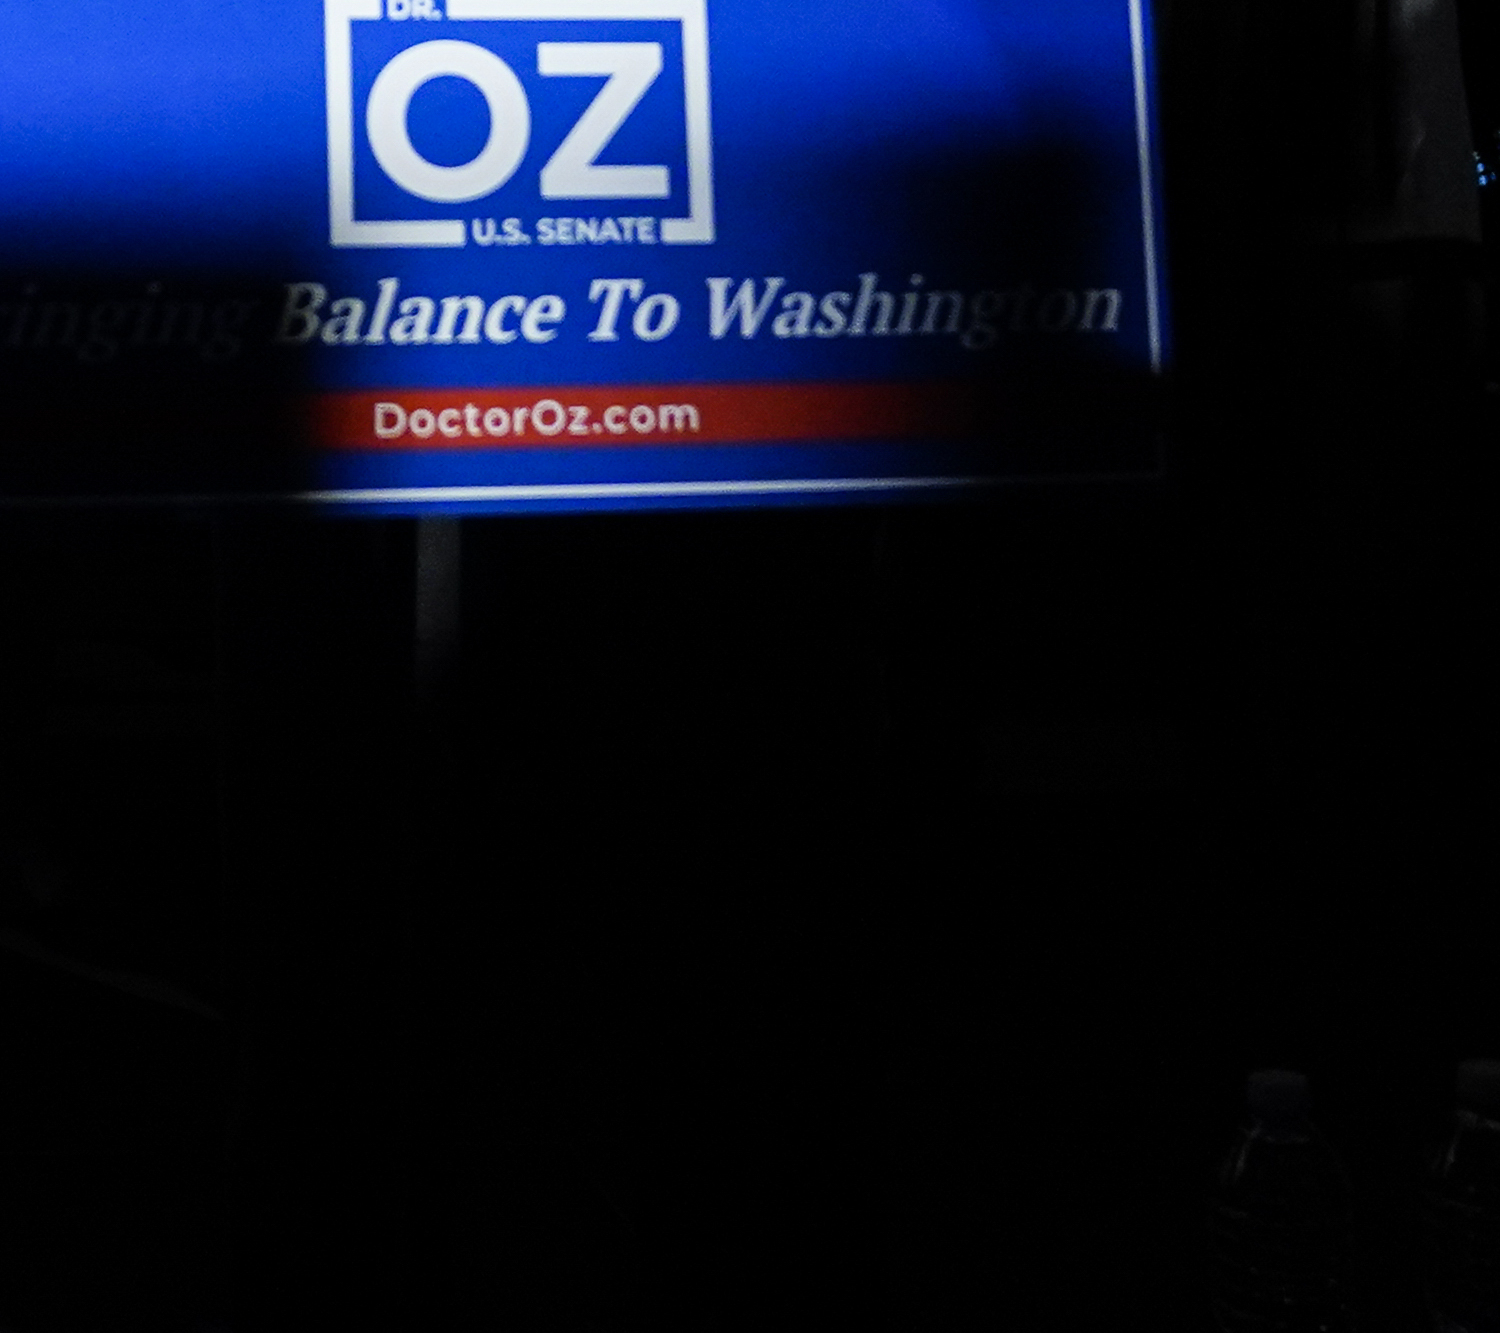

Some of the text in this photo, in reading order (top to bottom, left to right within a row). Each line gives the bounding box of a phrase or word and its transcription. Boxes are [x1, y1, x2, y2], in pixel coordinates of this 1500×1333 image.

[365, 38, 672, 205] OZ
[470, 215, 661, 248] U.S. SENATE
[278, 276, 567, 346] Balance
[586, 276, 682, 341] To
[704, 271, 1125, 350] Washington
[373, 398, 701, 439] DoctorOz.com
